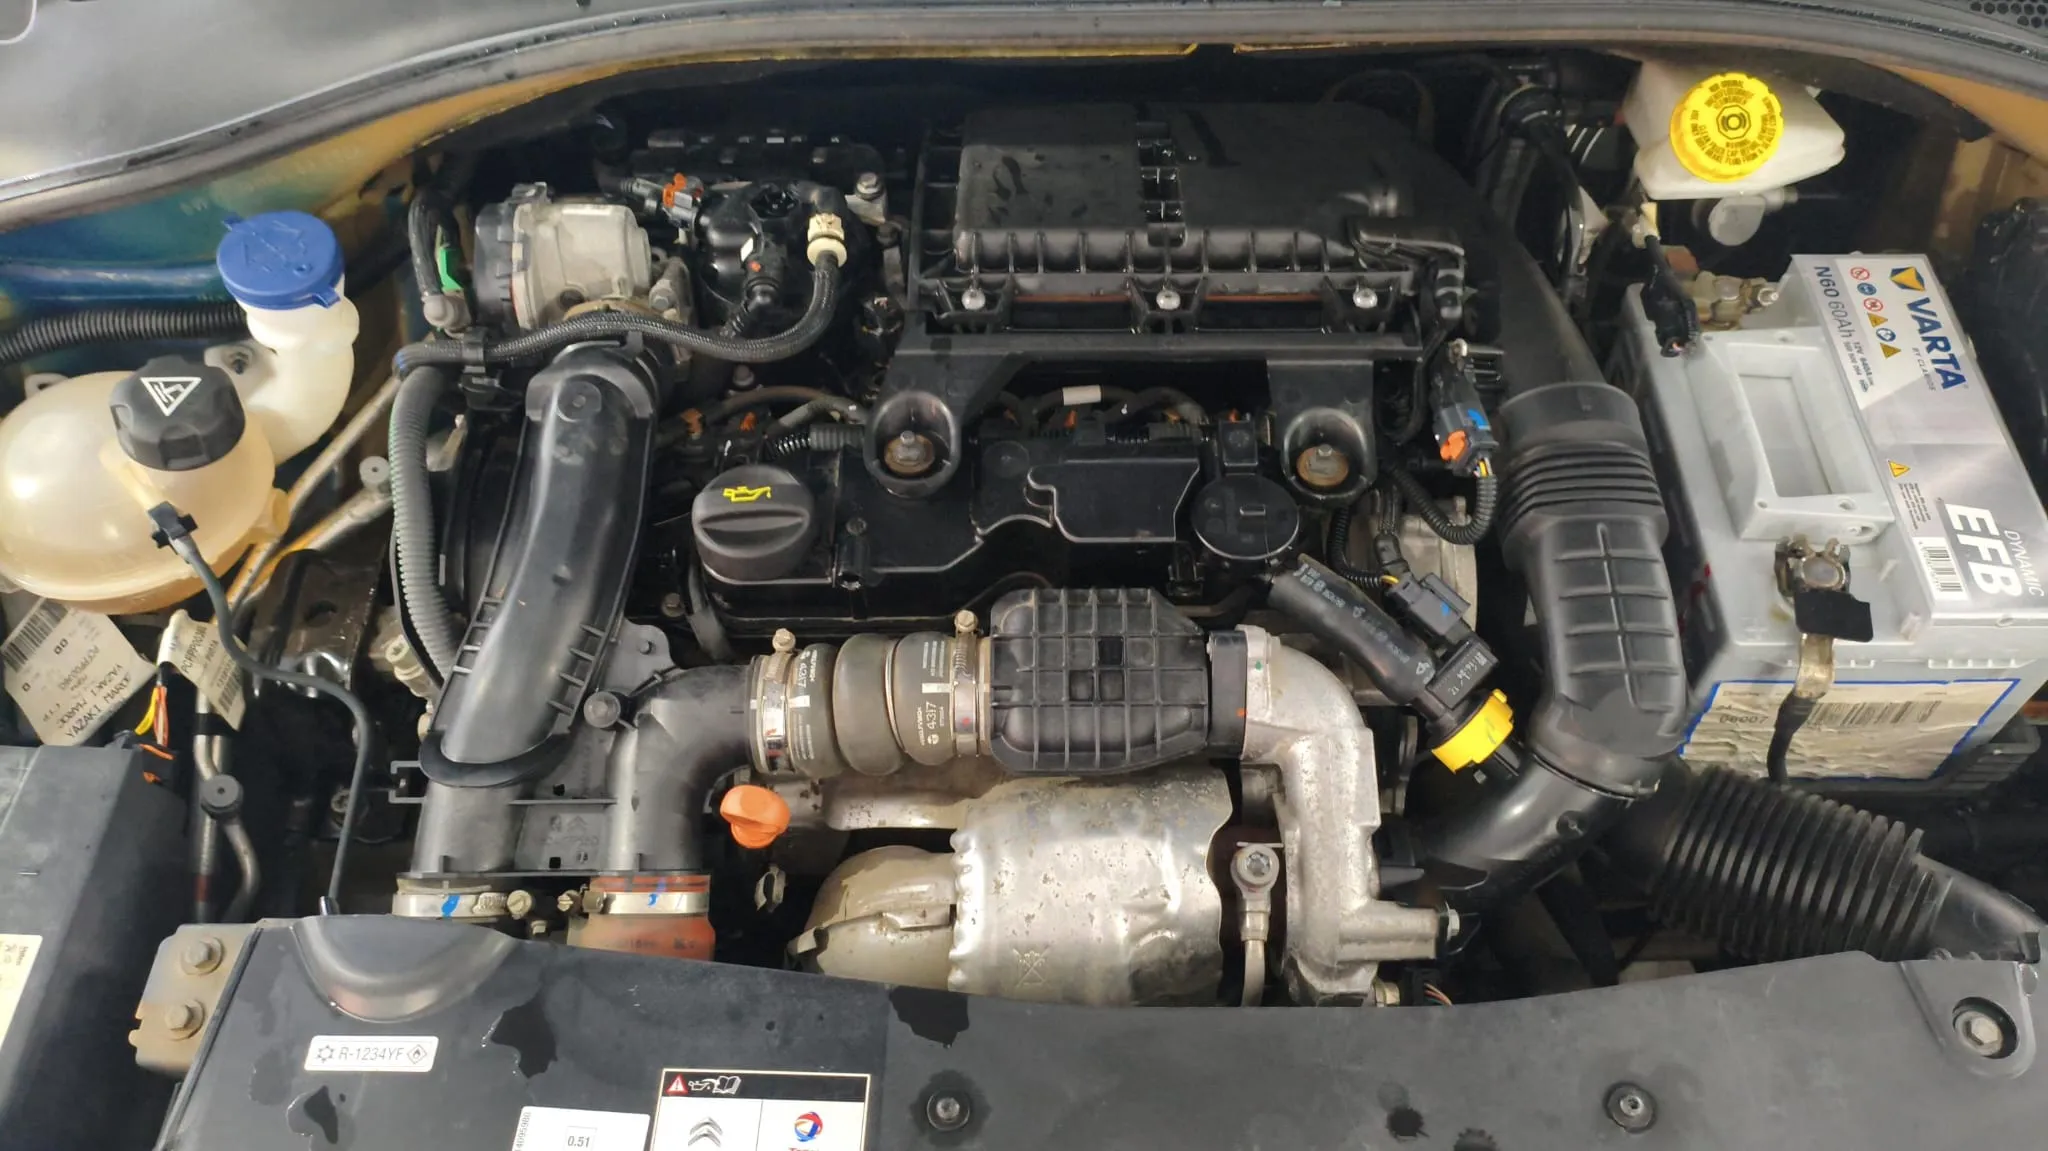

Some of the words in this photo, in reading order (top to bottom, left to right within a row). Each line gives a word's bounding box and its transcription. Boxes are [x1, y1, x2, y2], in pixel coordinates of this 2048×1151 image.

[1814, 265, 1840, 298] N60
[1828, 300, 1855, 339] 60Ah
[1907, 297, 1967, 389] VARTA
[1944, 504, 2023, 597] EFB
[2004, 530, 2045, 597] DYNAMIC
[64, 705, 102, 738] YAZAKI
[925, 701, 937, 730] 4317
[338, 1046, 405, 1061] R-1234YF
[567, 1135, 591, 1148] 0.51
